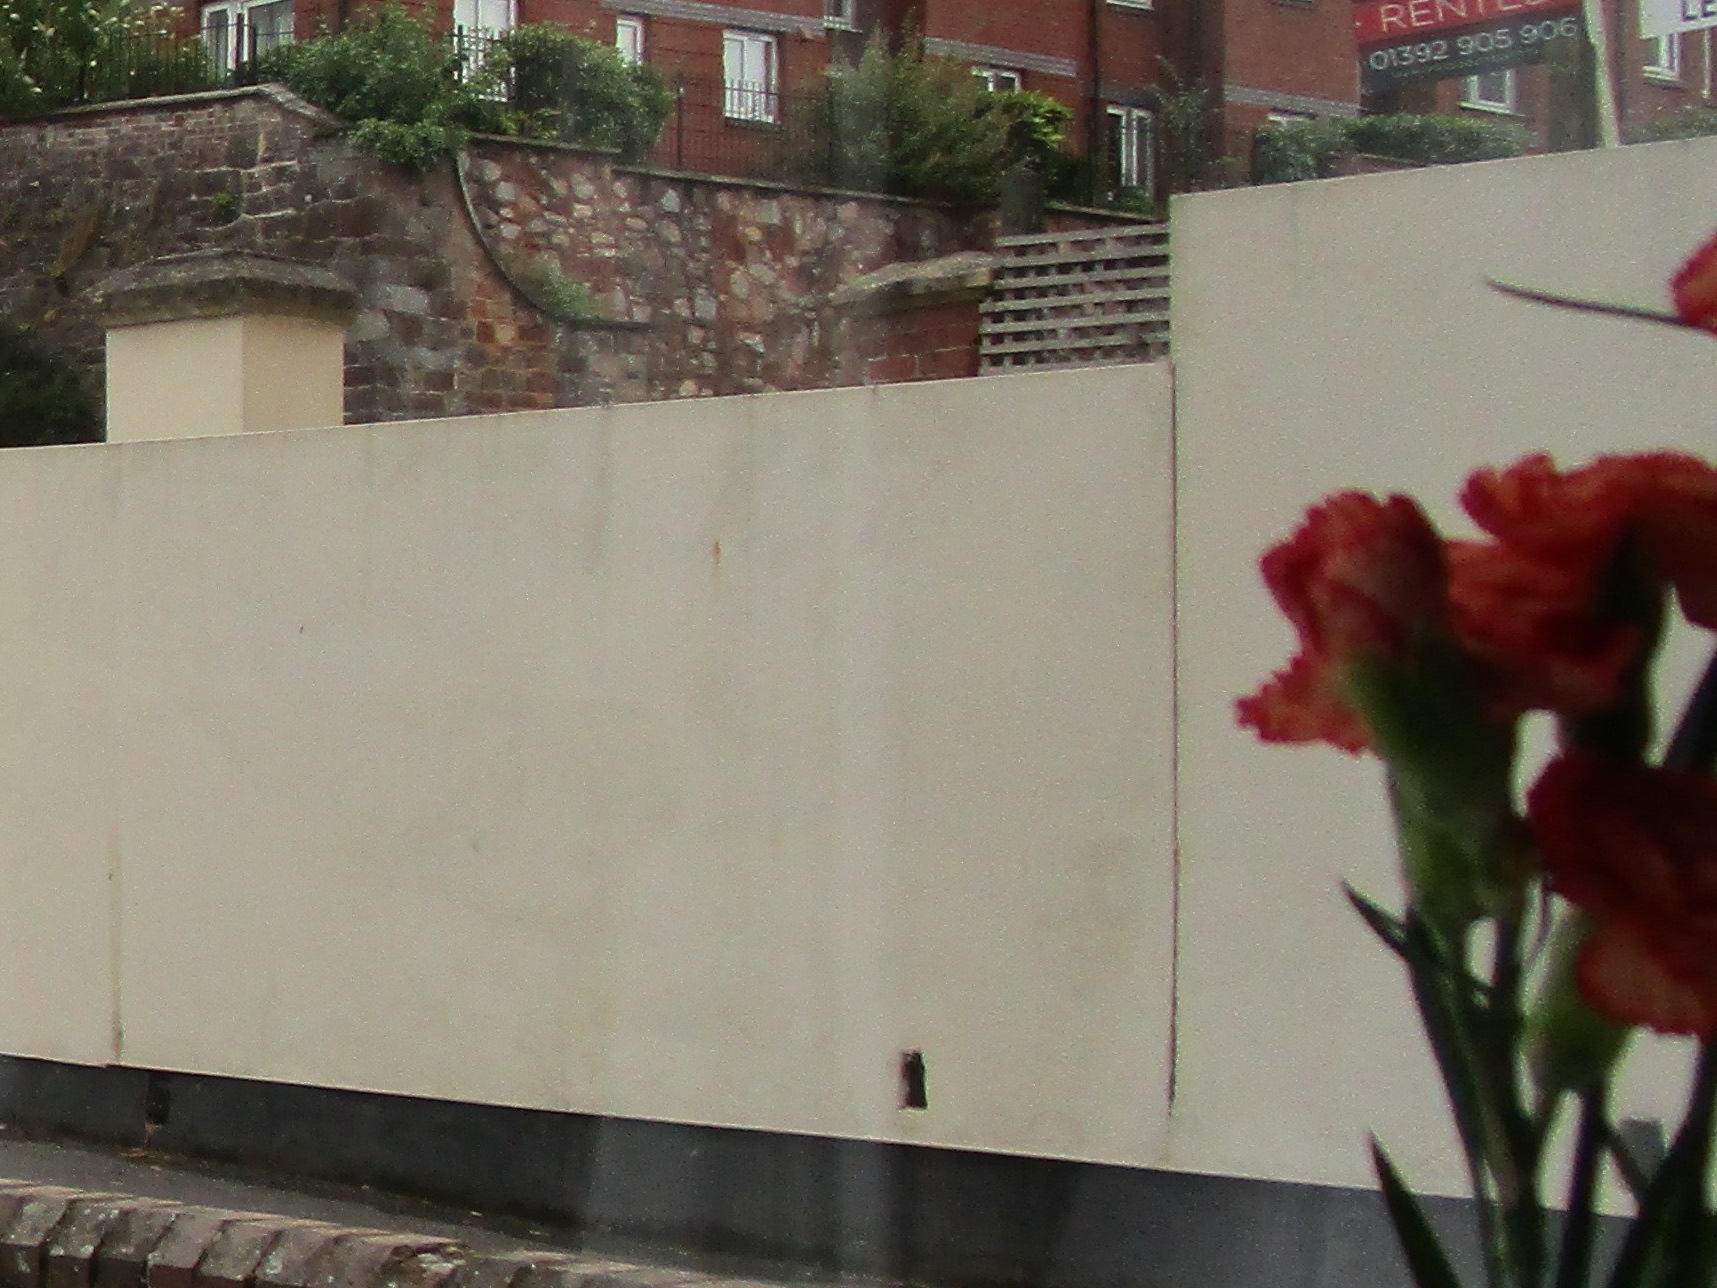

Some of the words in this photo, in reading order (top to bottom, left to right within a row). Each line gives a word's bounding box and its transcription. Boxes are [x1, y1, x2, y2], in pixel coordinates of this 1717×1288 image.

[1369, 40, 1449, 70] 01392
[1457, 29, 1513, 55] 905
[1519, 16, 1578, 44] 906
